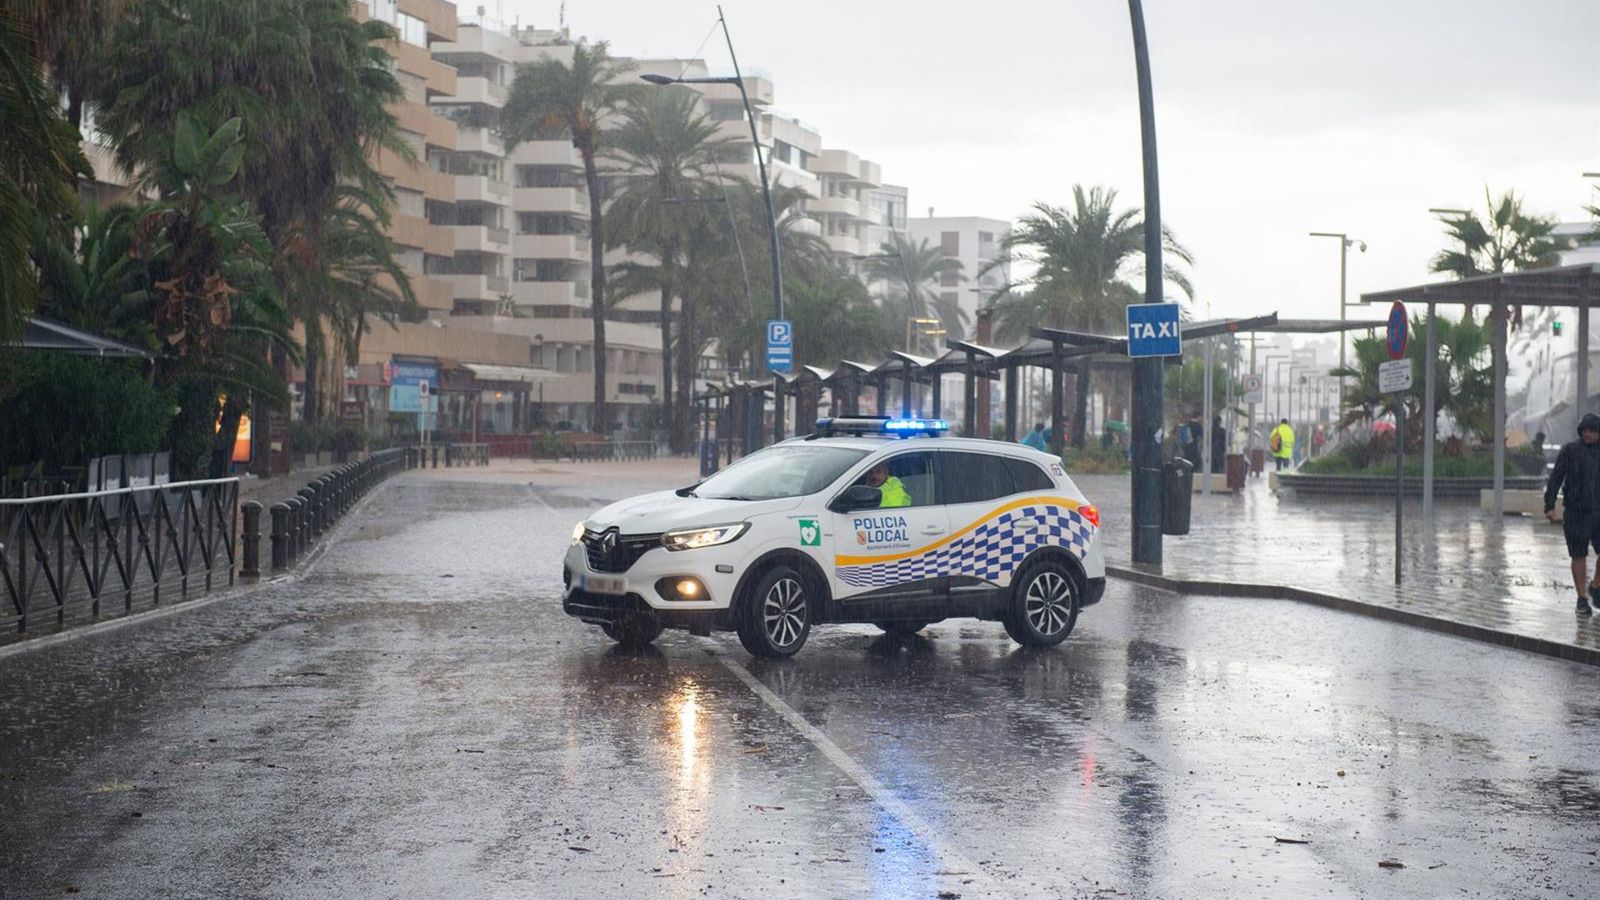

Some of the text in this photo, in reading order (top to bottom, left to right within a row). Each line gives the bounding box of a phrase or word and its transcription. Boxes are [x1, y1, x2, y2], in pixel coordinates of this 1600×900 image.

[773, 325, 786, 340] P
[1130, 321, 1178, 339] TAXI
[853, 516, 908, 530] POLICIA
[867, 529, 910, 543] LOCAL
